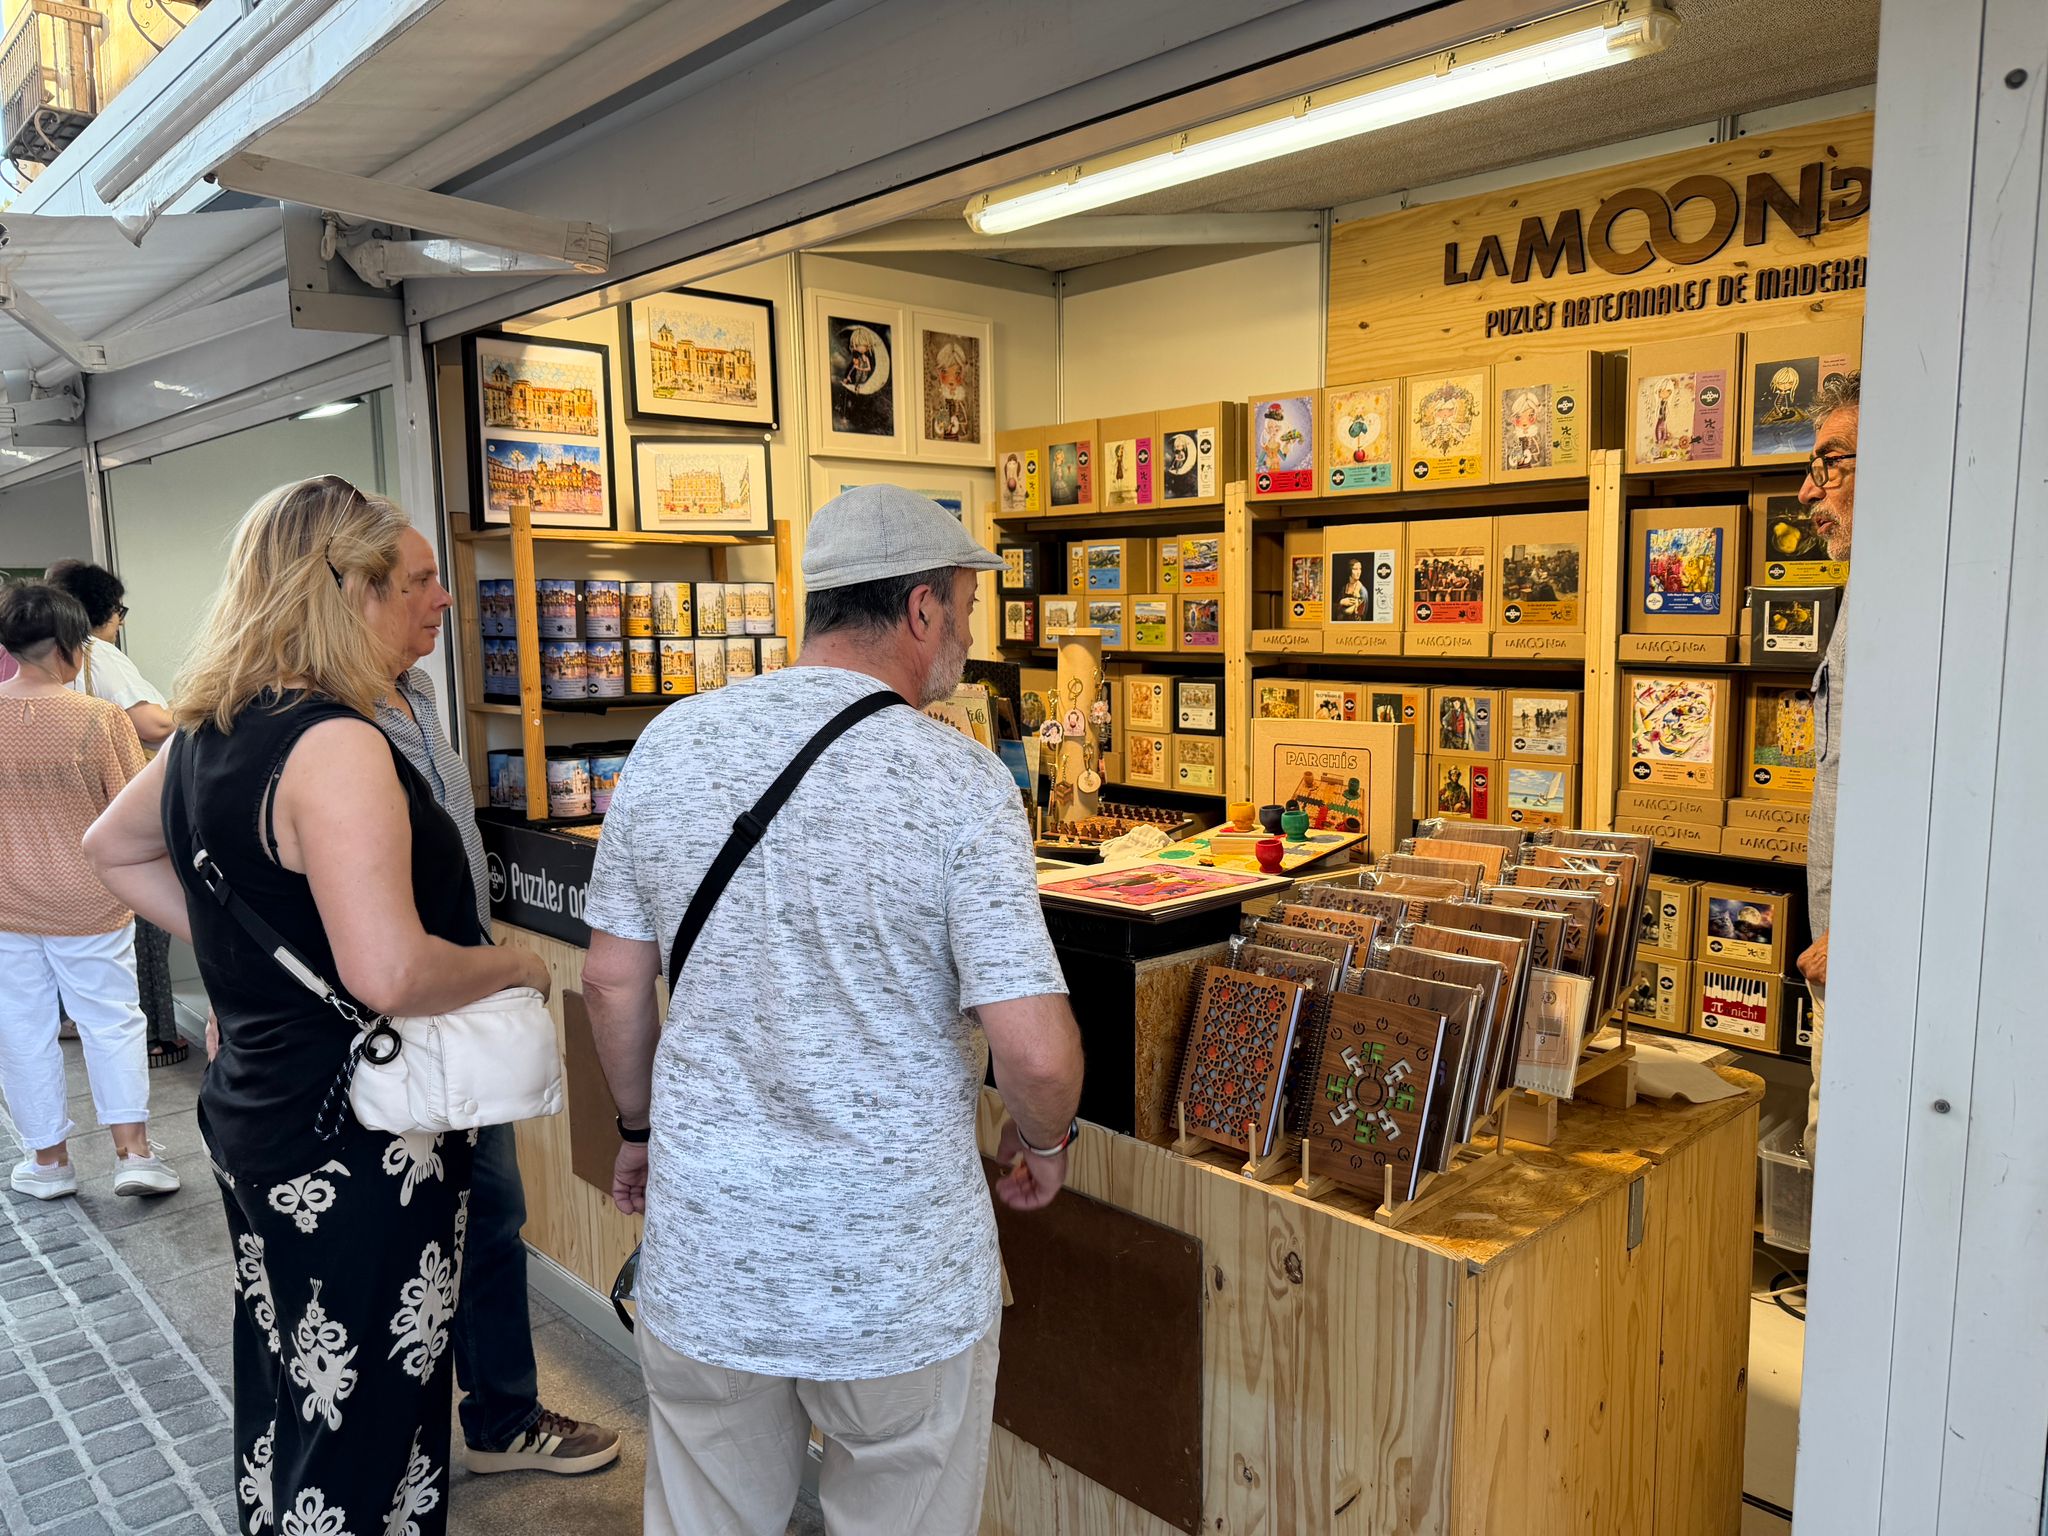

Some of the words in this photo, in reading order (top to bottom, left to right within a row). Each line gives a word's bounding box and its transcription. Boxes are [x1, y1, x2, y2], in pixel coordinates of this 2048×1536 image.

[1485, 301, 1555, 338] PUZLES
[1561, 278, 1711, 329] ARTESANALES
[1717, 271, 1748, 307] DE
[1755, 255, 1867, 302] MADERA
[1286, 751, 1358, 770] PARCHÍS
[511, 862, 565, 913] Puzzles
[1731, 1007, 1758, 1020] nicht
